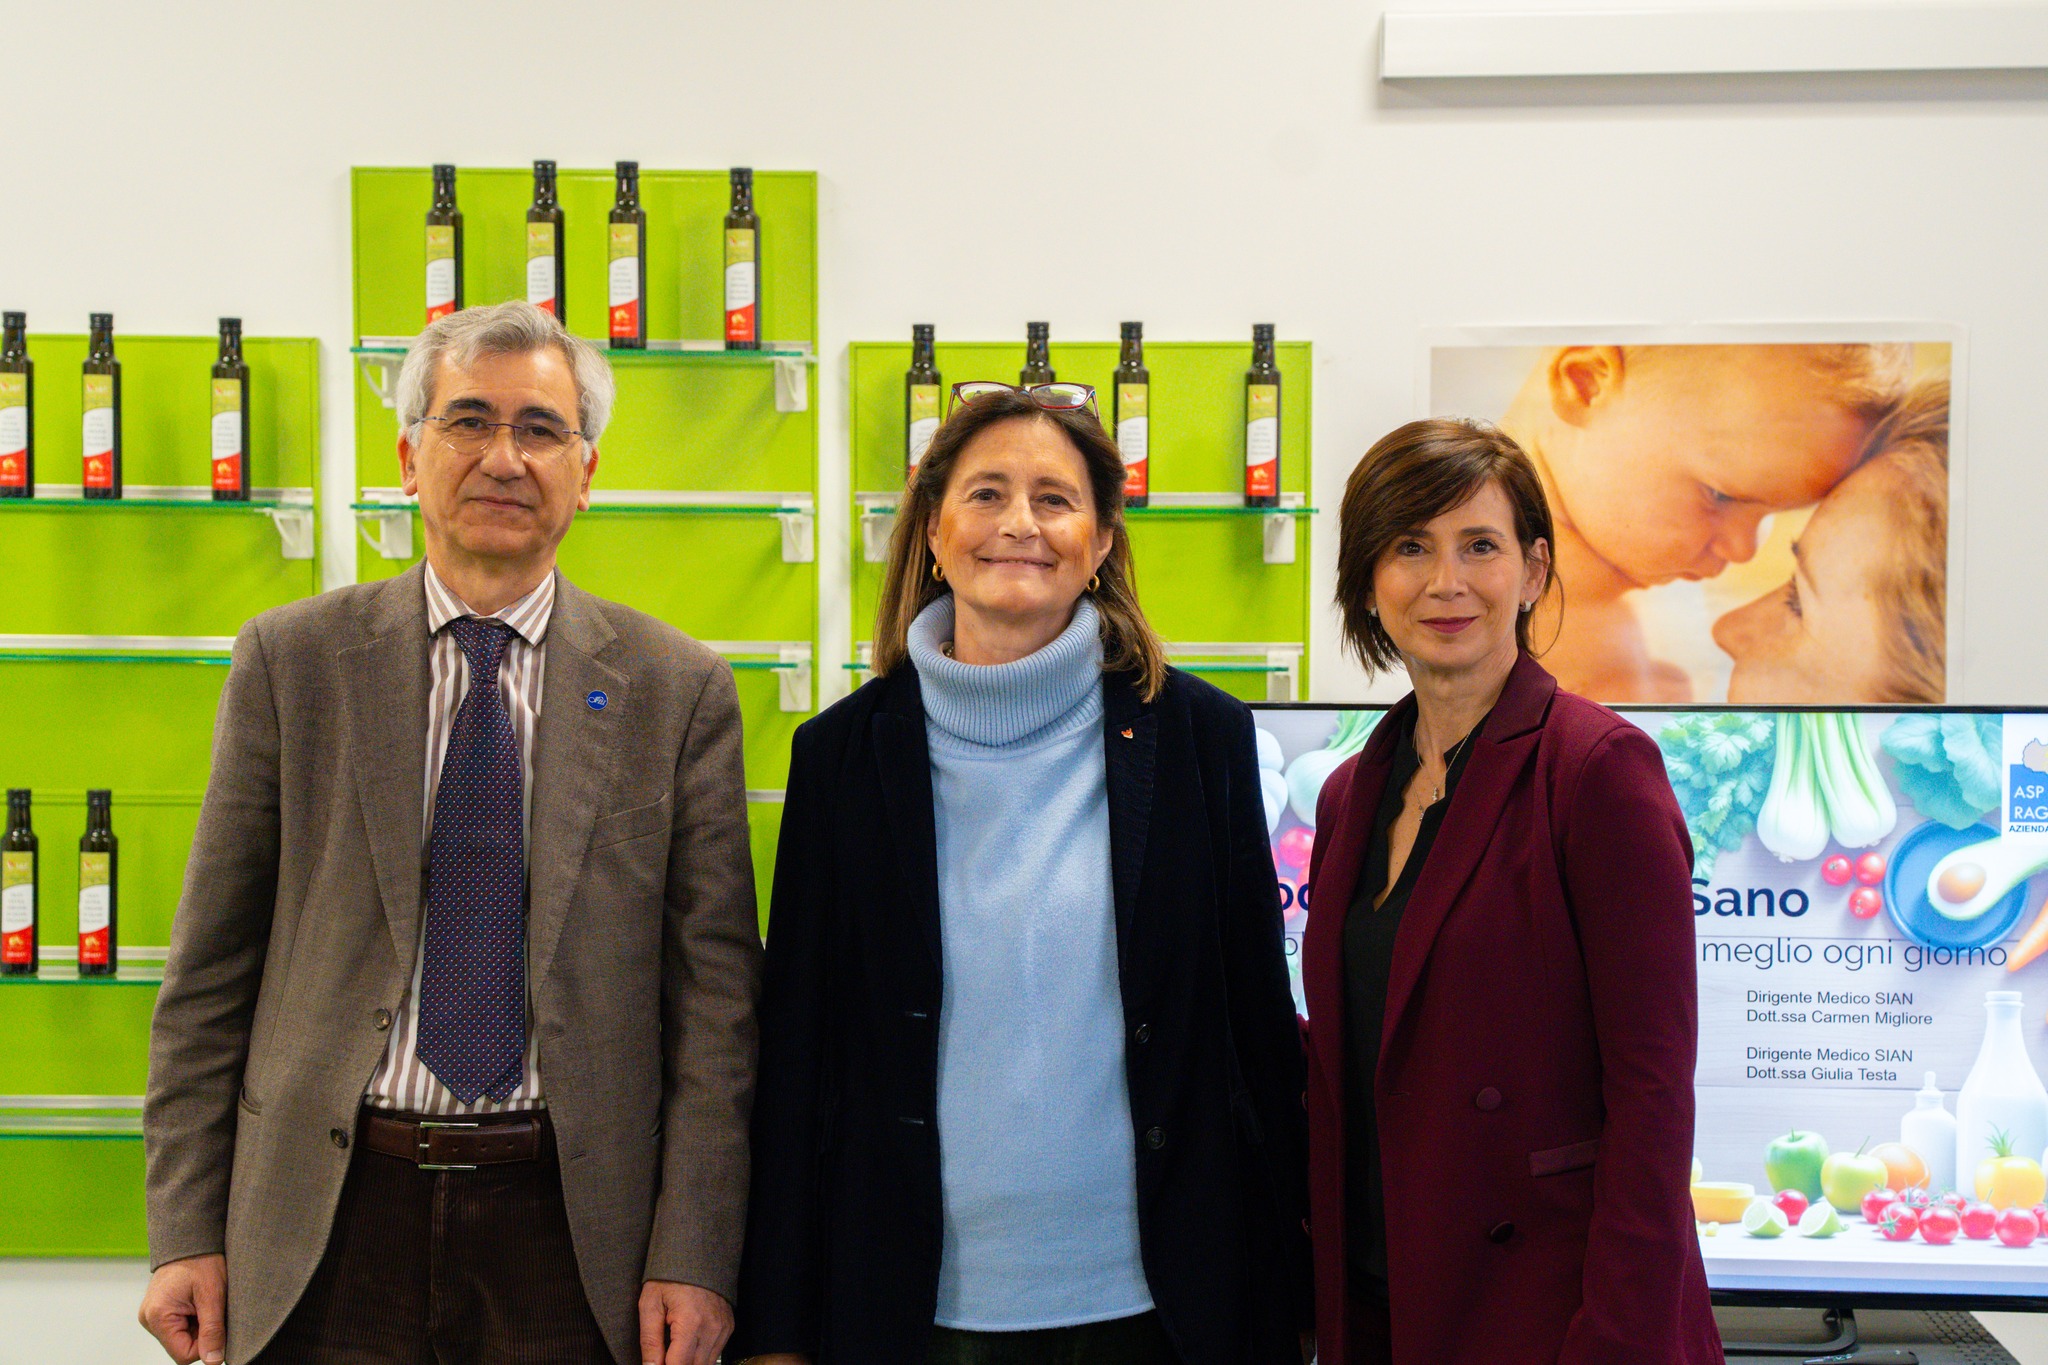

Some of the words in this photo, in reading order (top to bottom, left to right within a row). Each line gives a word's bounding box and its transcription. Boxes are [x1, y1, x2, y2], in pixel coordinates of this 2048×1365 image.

[2014, 785, 2045, 799] ASP
[1692, 877, 1810, 918] Sano
[1702, 937, 1813, 971] meglio
[1823, 939, 1895, 972] ogni
[1903, 940, 2009, 973] giorno
[1746, 990, 1812, 1007] Dirigente
[1817, 991, 1871, 1005] Medico
[1875, 992, 1913, 1005] SIAN
[1746, 1009, 1807, 1023] Dott.ssa
[1811, 1010, 1870, 1024] Carmen
[1875, 1011, 1933, 1027] Migliore
[1746, 1046, 1812, 1063] Dirigente
[1817, 1048, 1870, 1062] Medico
[1875, 1049, 1913, 1062] SIAN
[1746, 1066, 1807, 1080] Dott.ssa
[1811, 1067, 1853, 1081] Giulia
[1858, 1068, 1897, 1082] Testa
